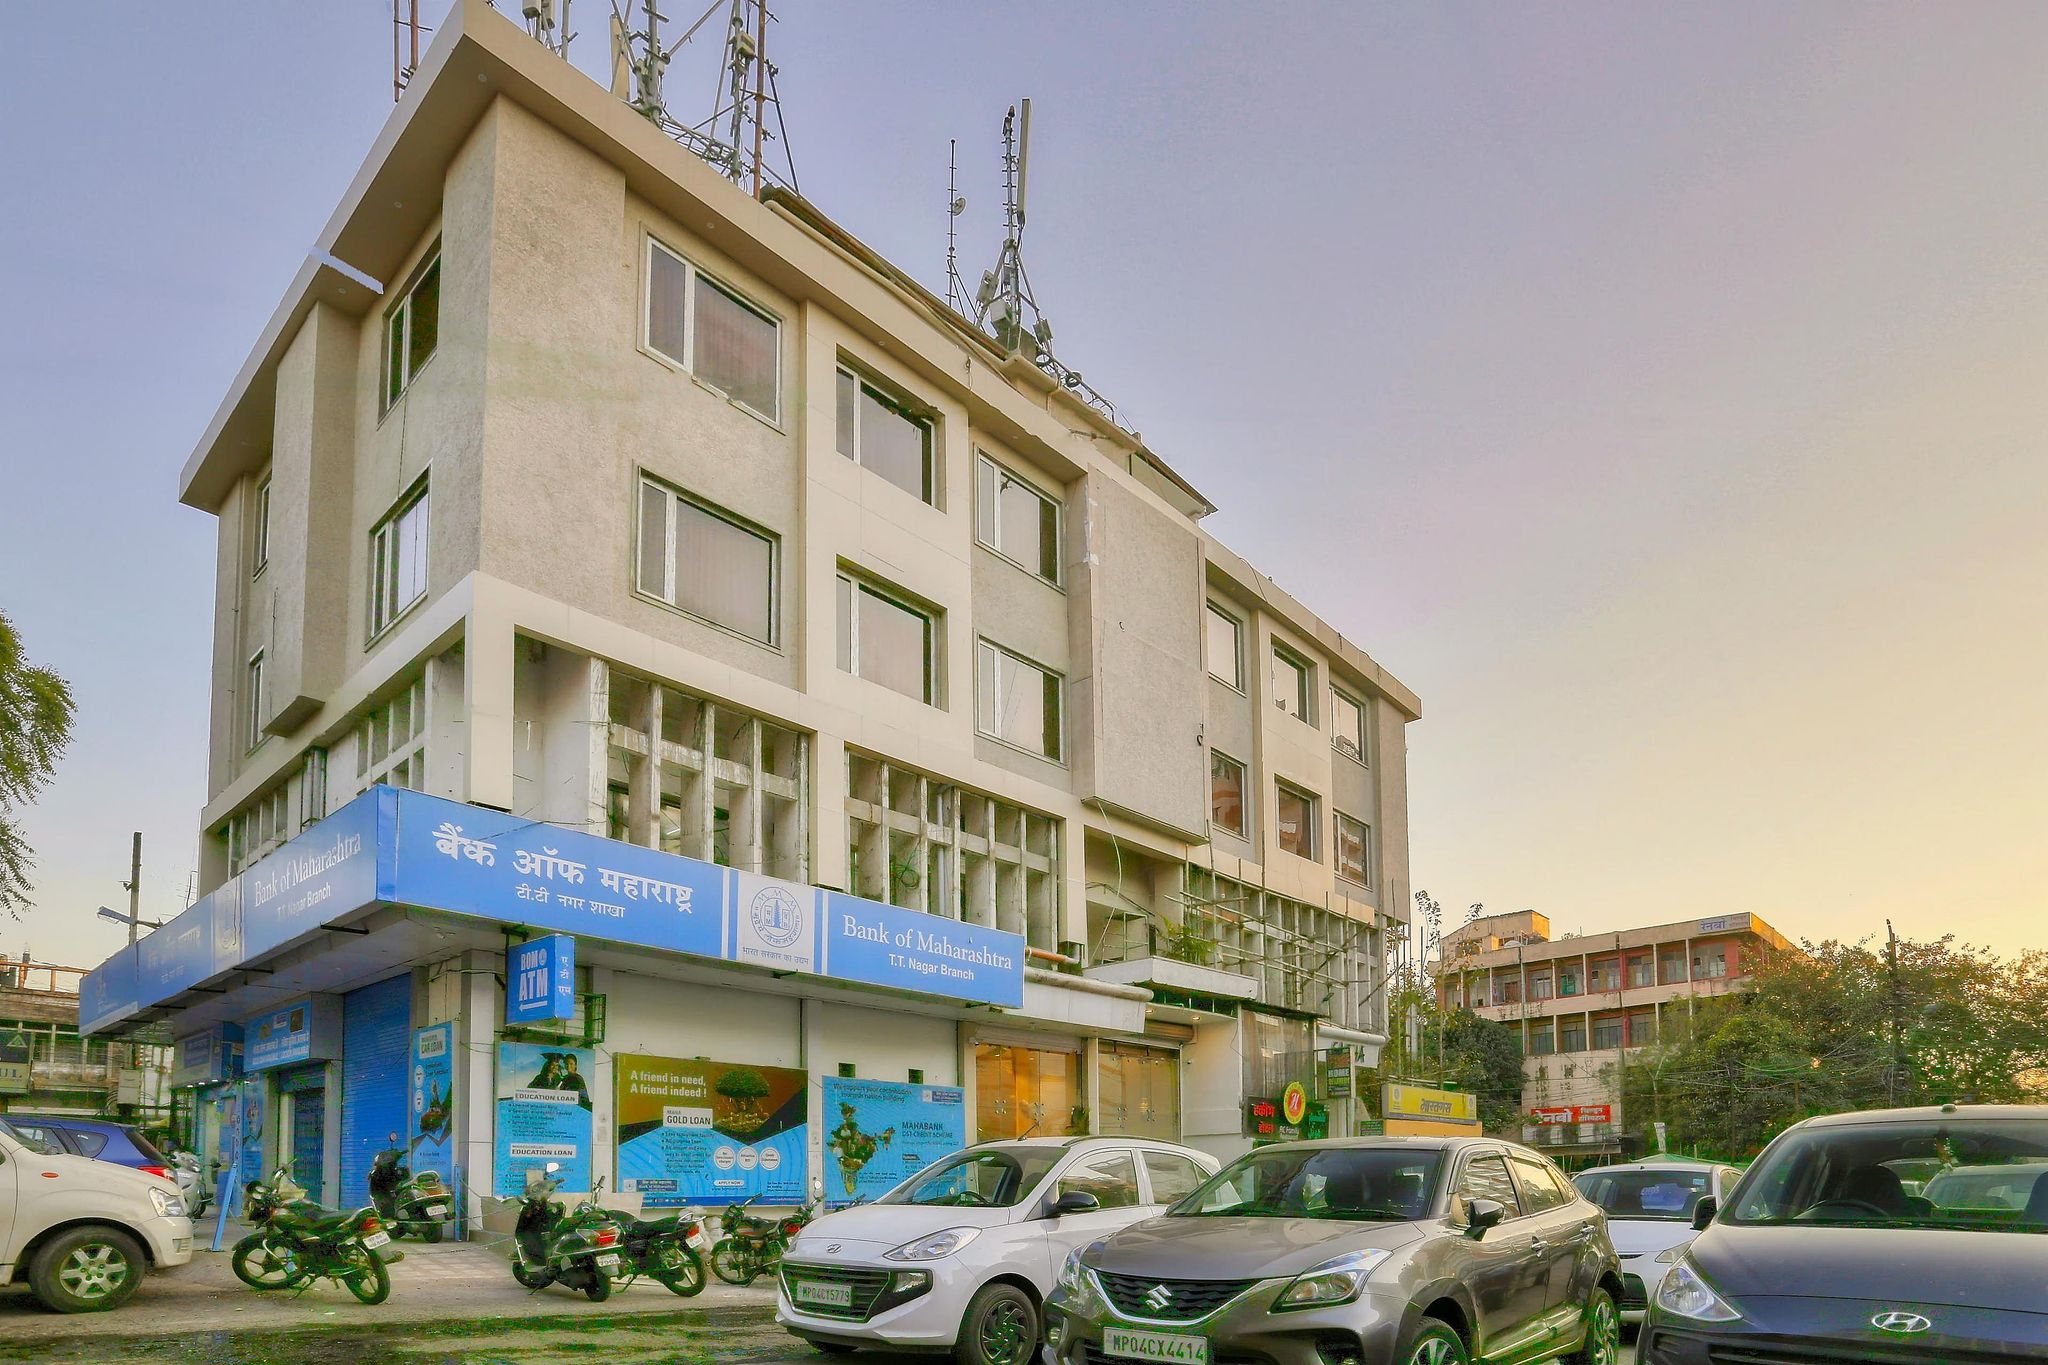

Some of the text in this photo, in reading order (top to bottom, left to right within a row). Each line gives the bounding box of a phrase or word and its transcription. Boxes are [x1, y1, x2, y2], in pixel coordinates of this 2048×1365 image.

[255, 832, 361, 907] Bank of Maharashtra
[432, 822, 694, 914] बैंक ऑफ महाराष्ट्र
[307, 882, 331, 907] Branch
[557, 893, 585, 911] नगर
[589, 900, 626, 918] शाखा
[842, 914, 1012, 970] Bank of Maharashtra
[521, 950, 538, 971] BOM
[889, 954, 975, 981] T.T. Nagar Branch
[519, 968, 548, 1001] ATM
[630, 1070, 706, 1086] A friend in need,
[630, 1083, 638, 1093] A
[640, 1084, 668, 1095] friend
[670, 1086, 701, 1097] indeed
[515, 1093, 556, 1102] EDUCATION
[667, 1115, 711, 1125] GOLD LOAN
[1113, 1335, 1204, 1361] MP04CX4414
